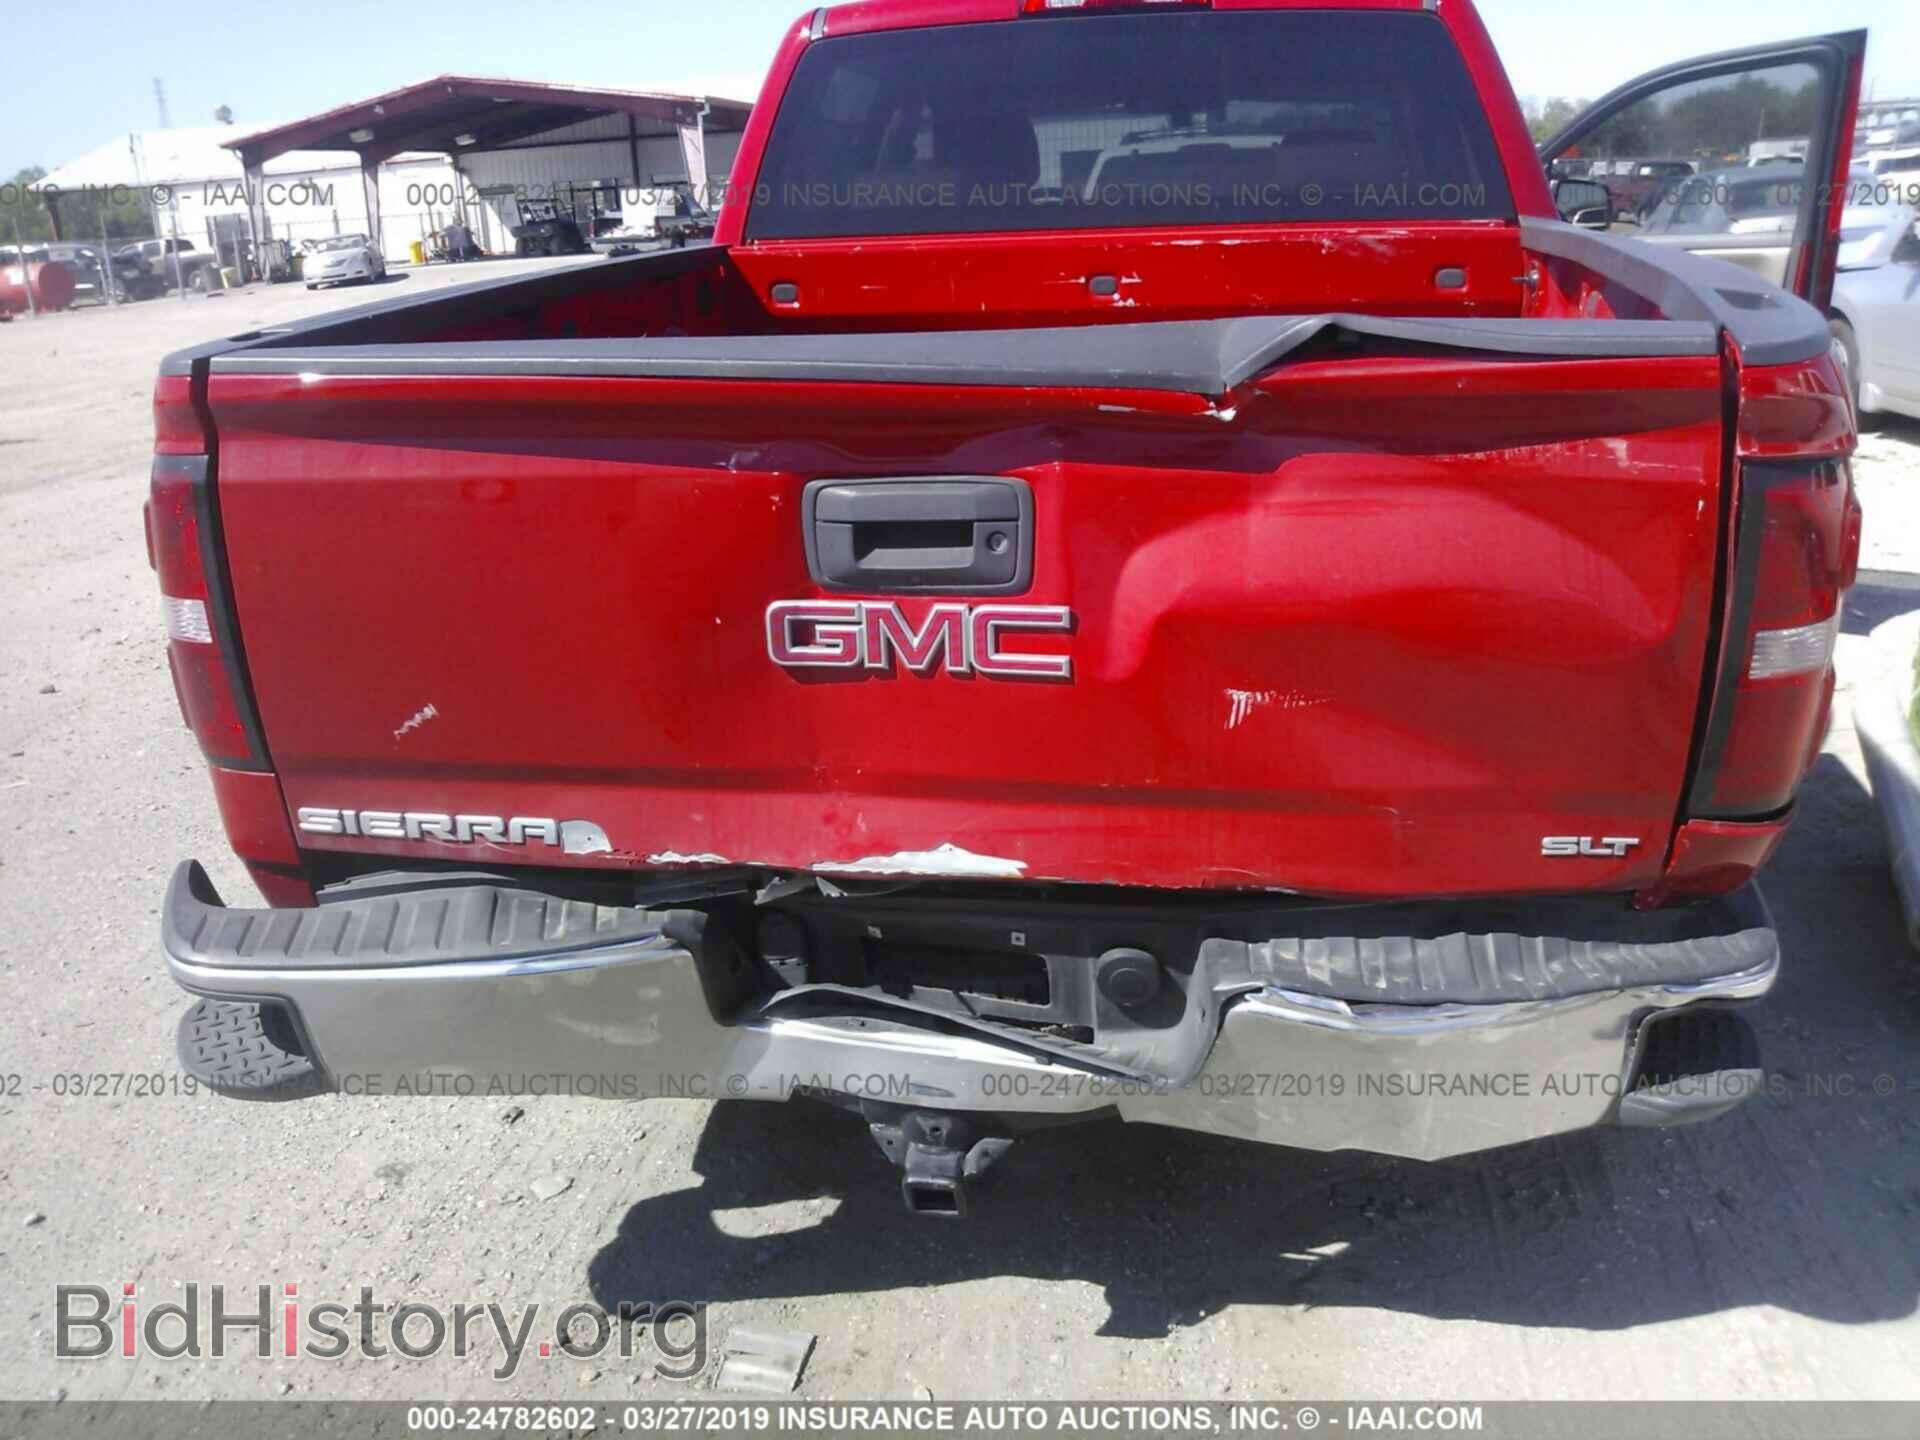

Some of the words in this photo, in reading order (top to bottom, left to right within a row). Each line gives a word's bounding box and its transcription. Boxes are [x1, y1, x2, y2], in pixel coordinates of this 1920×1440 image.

[766, 600, 1071, 678] GMC
[298, 807, 559, 846] SIERRA
[1541, 836, 1640, 856] SLT
